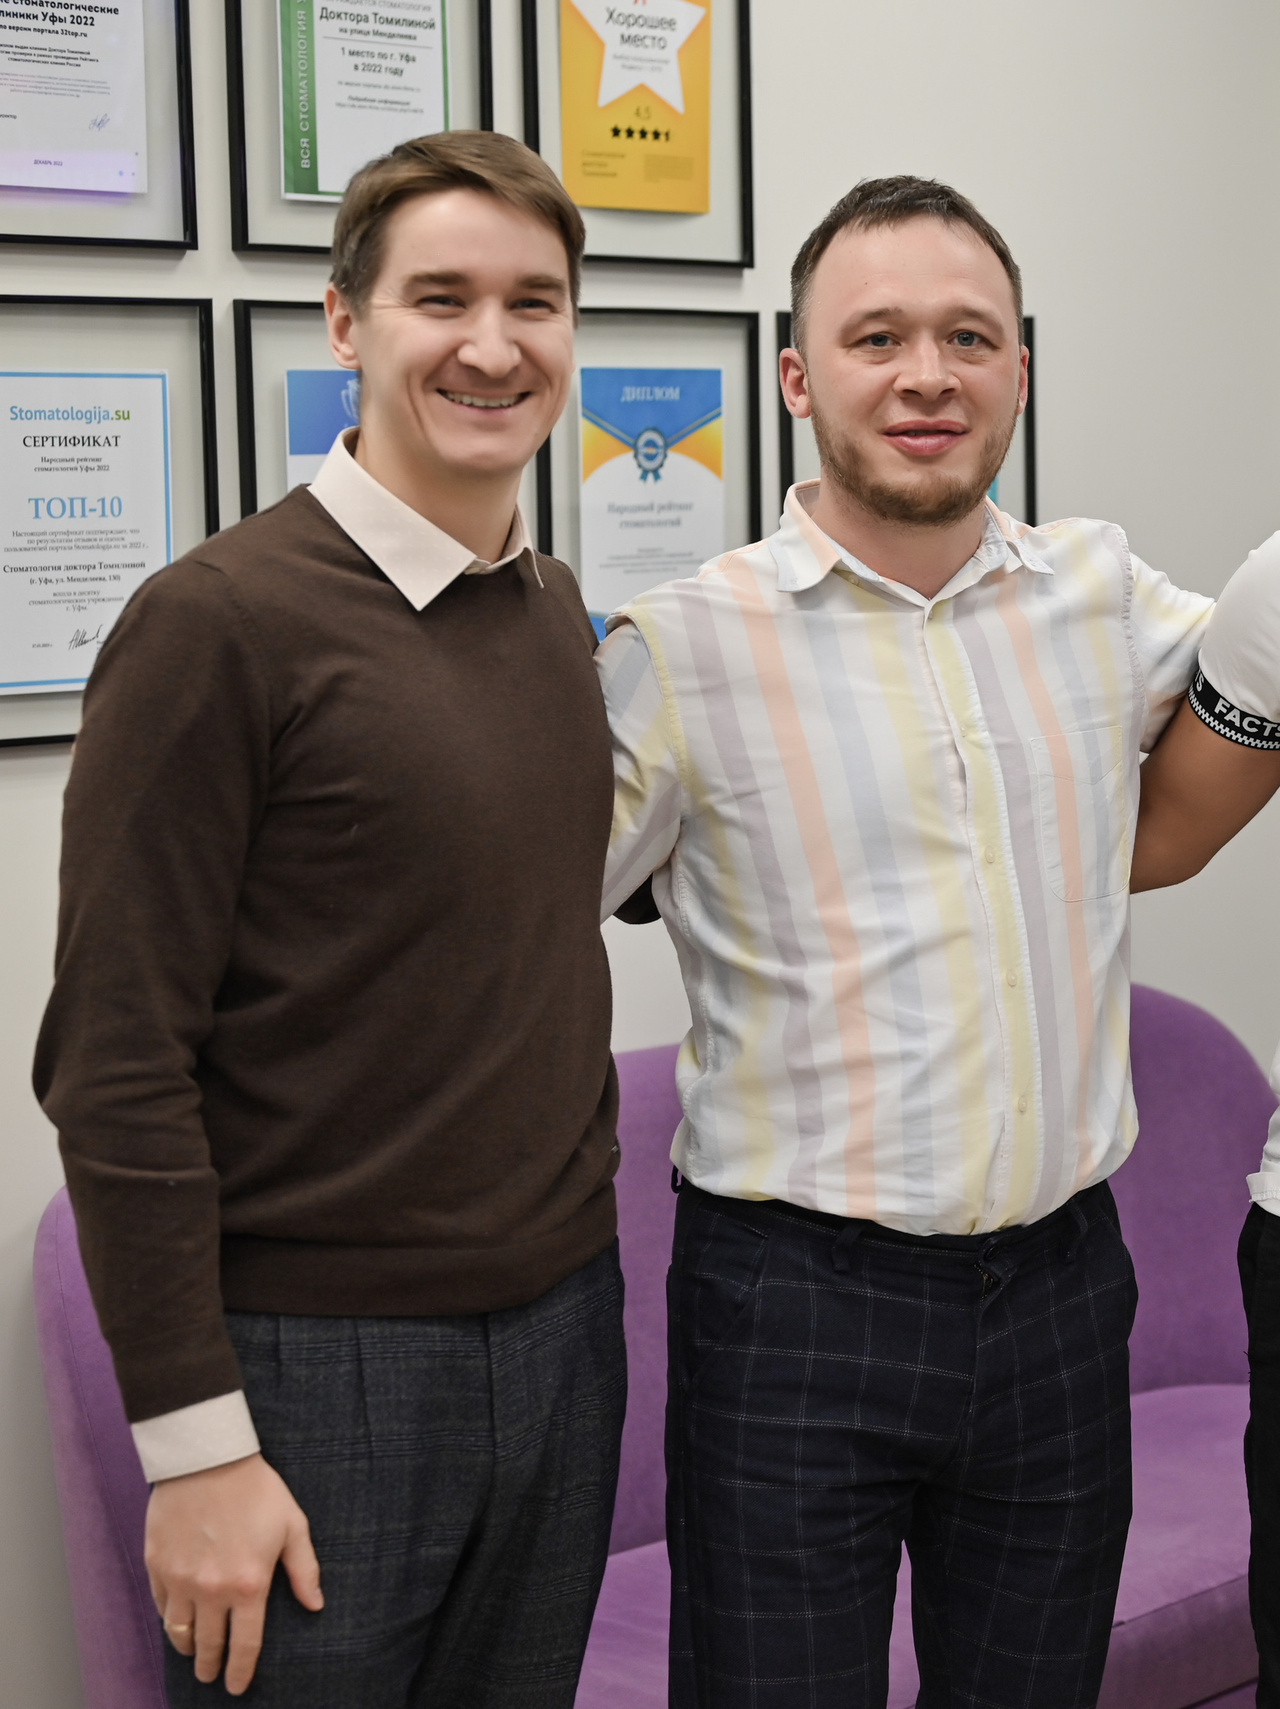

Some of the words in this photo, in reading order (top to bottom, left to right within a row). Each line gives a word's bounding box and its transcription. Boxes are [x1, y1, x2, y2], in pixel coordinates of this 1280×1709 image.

[12, 0, 119, 15] стоматологические
[41, 11, 67, 26] Уфы
[69, 14, 95, 27] 2022
[319, 7, 370, 25] Доктора
[371, 12, 436, 30] Томилиной
[605, 6, 677, 32] Хорошее
[8, 25, 32, 33] версии
[33, 27, 59, 35] портала
[60, 28, 88, 38] 32top.ru
[620, 32, 668, 51] место
[341, 46, 346, 56] 1
[348, 49, 376, 59] место
[399, 52, 416, 64] Уфа
[296, 10, 310, 132] СТОМАТОЛОГИЯ
[361, 62, 382, 74] 2022
[384, 66, 405, 78] году
[300, 138, 311, 169] ВСЯ
[621, 385, 681, 402] ДИПЛОМ
[9, 405, 131, 425] Stomatologija.su
[22, 435, 121, 448] СЕРТИФИКАТ
[33, 465, 79, 473] стоматологий
[79, 464, 95, 473] Уфы
[96, 464, 110, 472] 2022
[40, 456, 75, 464] Народный
[76, 456, 102, 464] рейтинг
[28, 496, 123, 520] ТОП-10
[3, 564, 62, 574] Стоматология
[63, 563, 97, 573] доктора
[98, 561, 146, 570] Томилиной
